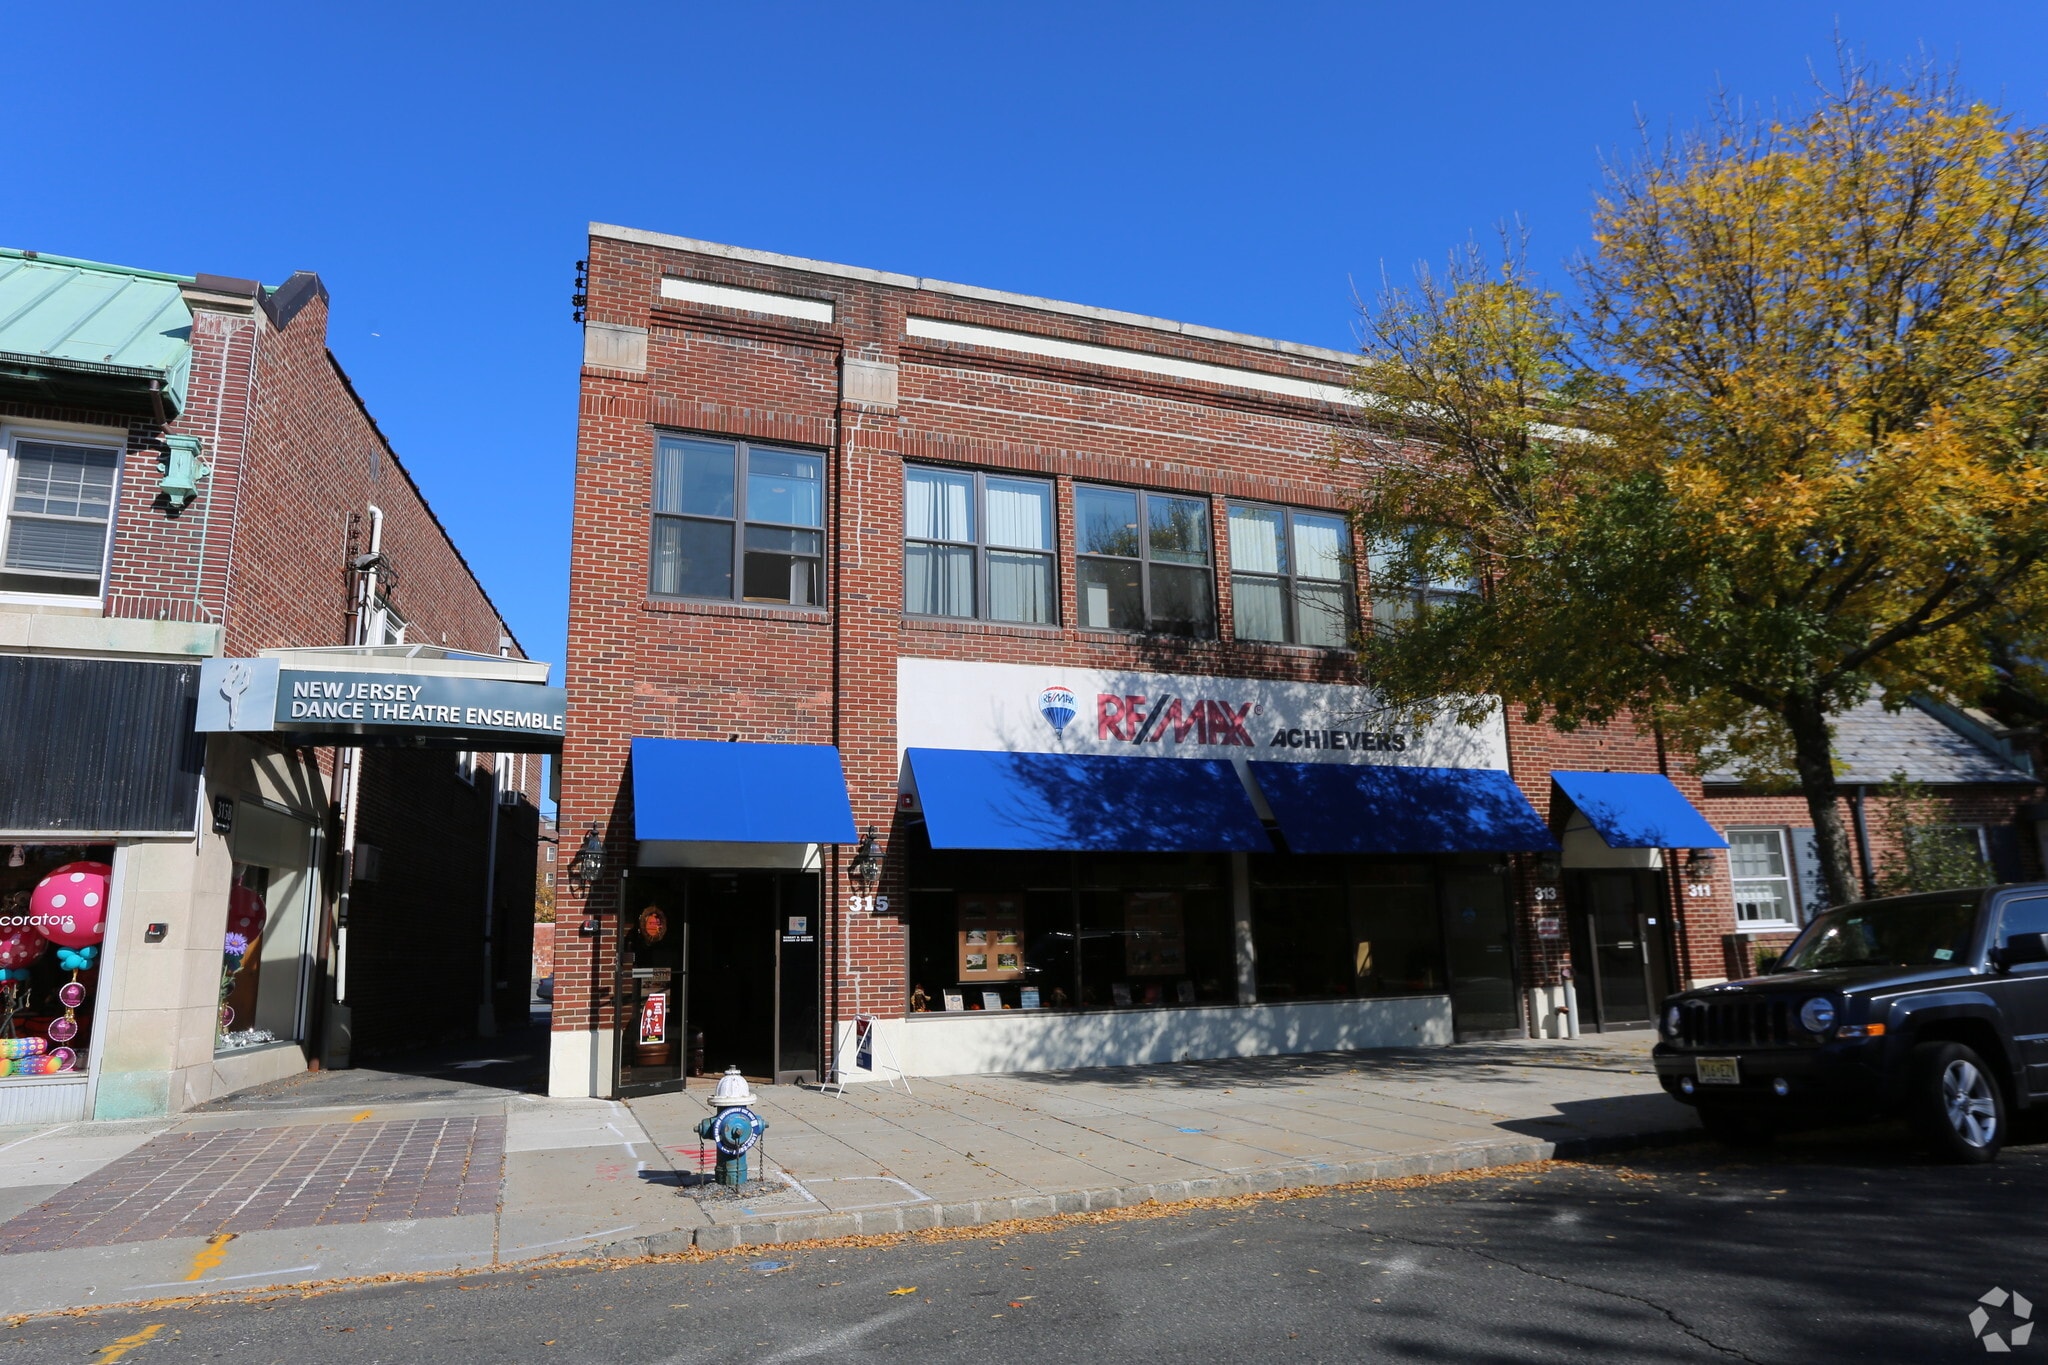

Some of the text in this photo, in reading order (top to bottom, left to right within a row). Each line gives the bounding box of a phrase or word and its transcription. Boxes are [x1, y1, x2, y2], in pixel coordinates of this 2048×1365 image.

[293, 681, 422, 701] NEW JERSEY
[1043, 693, 1074, 705] RE/MAX
[291, 701, 562, 731] DANCE THEATRE ENSEMBLE
[1097, 694, 1255, 746] RE/MAX
[1270, 728, 1406, 752] ACHIEVERS
[1534, 887, 1557, 900] 313
[1688, 884, 1711, 897] 311
[849, 895, 889, 912] 315
[0, 912, 74, 926] corators
